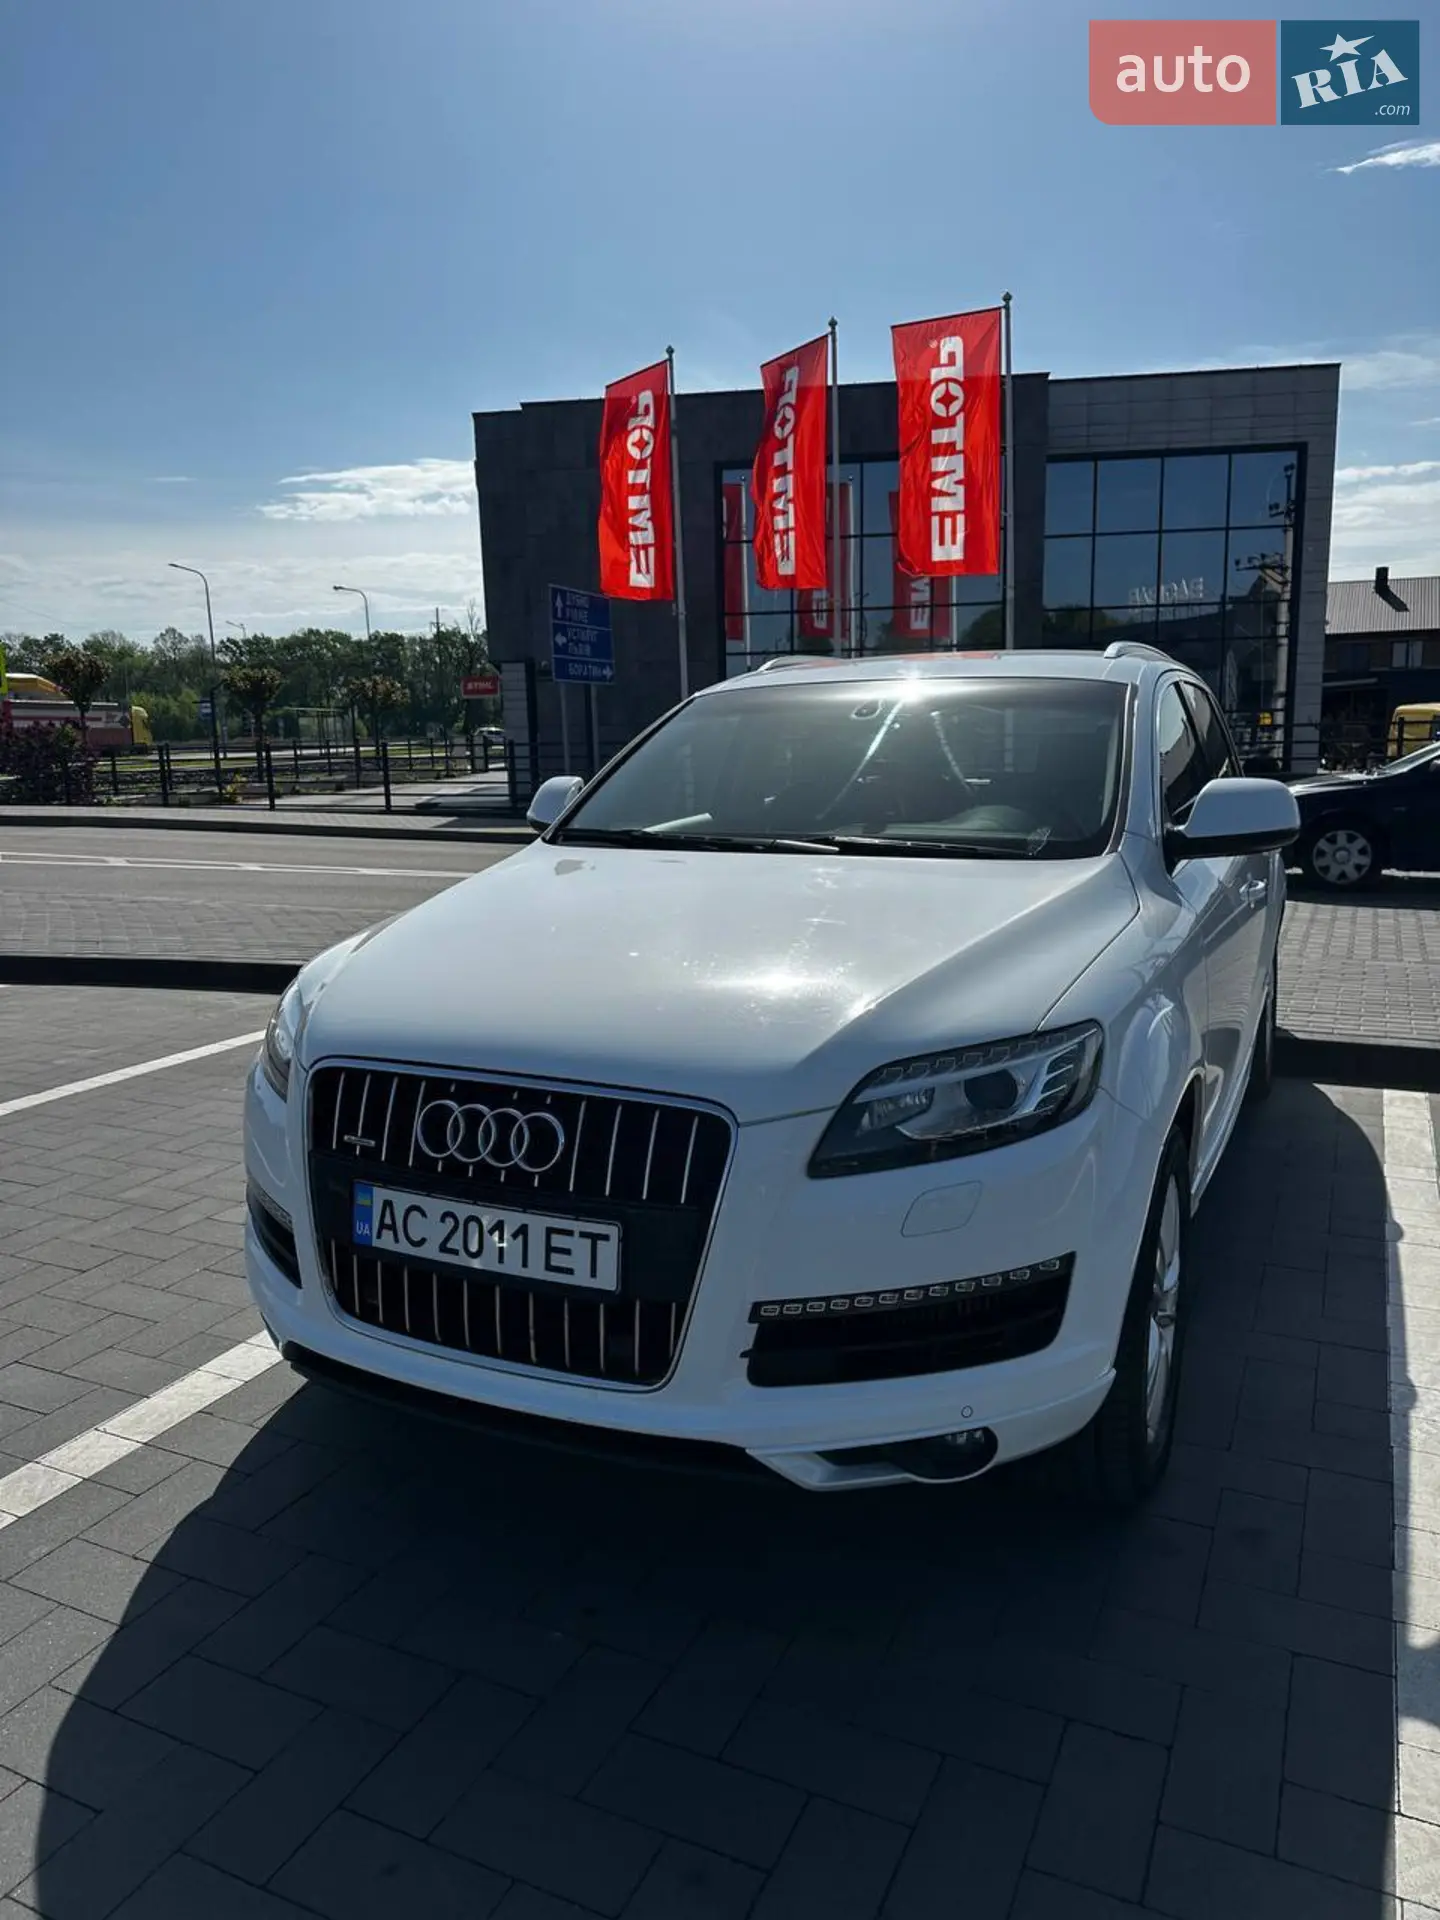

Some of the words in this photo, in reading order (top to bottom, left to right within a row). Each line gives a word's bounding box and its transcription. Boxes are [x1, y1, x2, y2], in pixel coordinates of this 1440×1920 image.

[355, 1219, 372, 1237] UA
[376, 1199, 428, 1248] AC
[438, 1211, 529, 1269] 2011
[545, 1226, 611, 1280] ET
